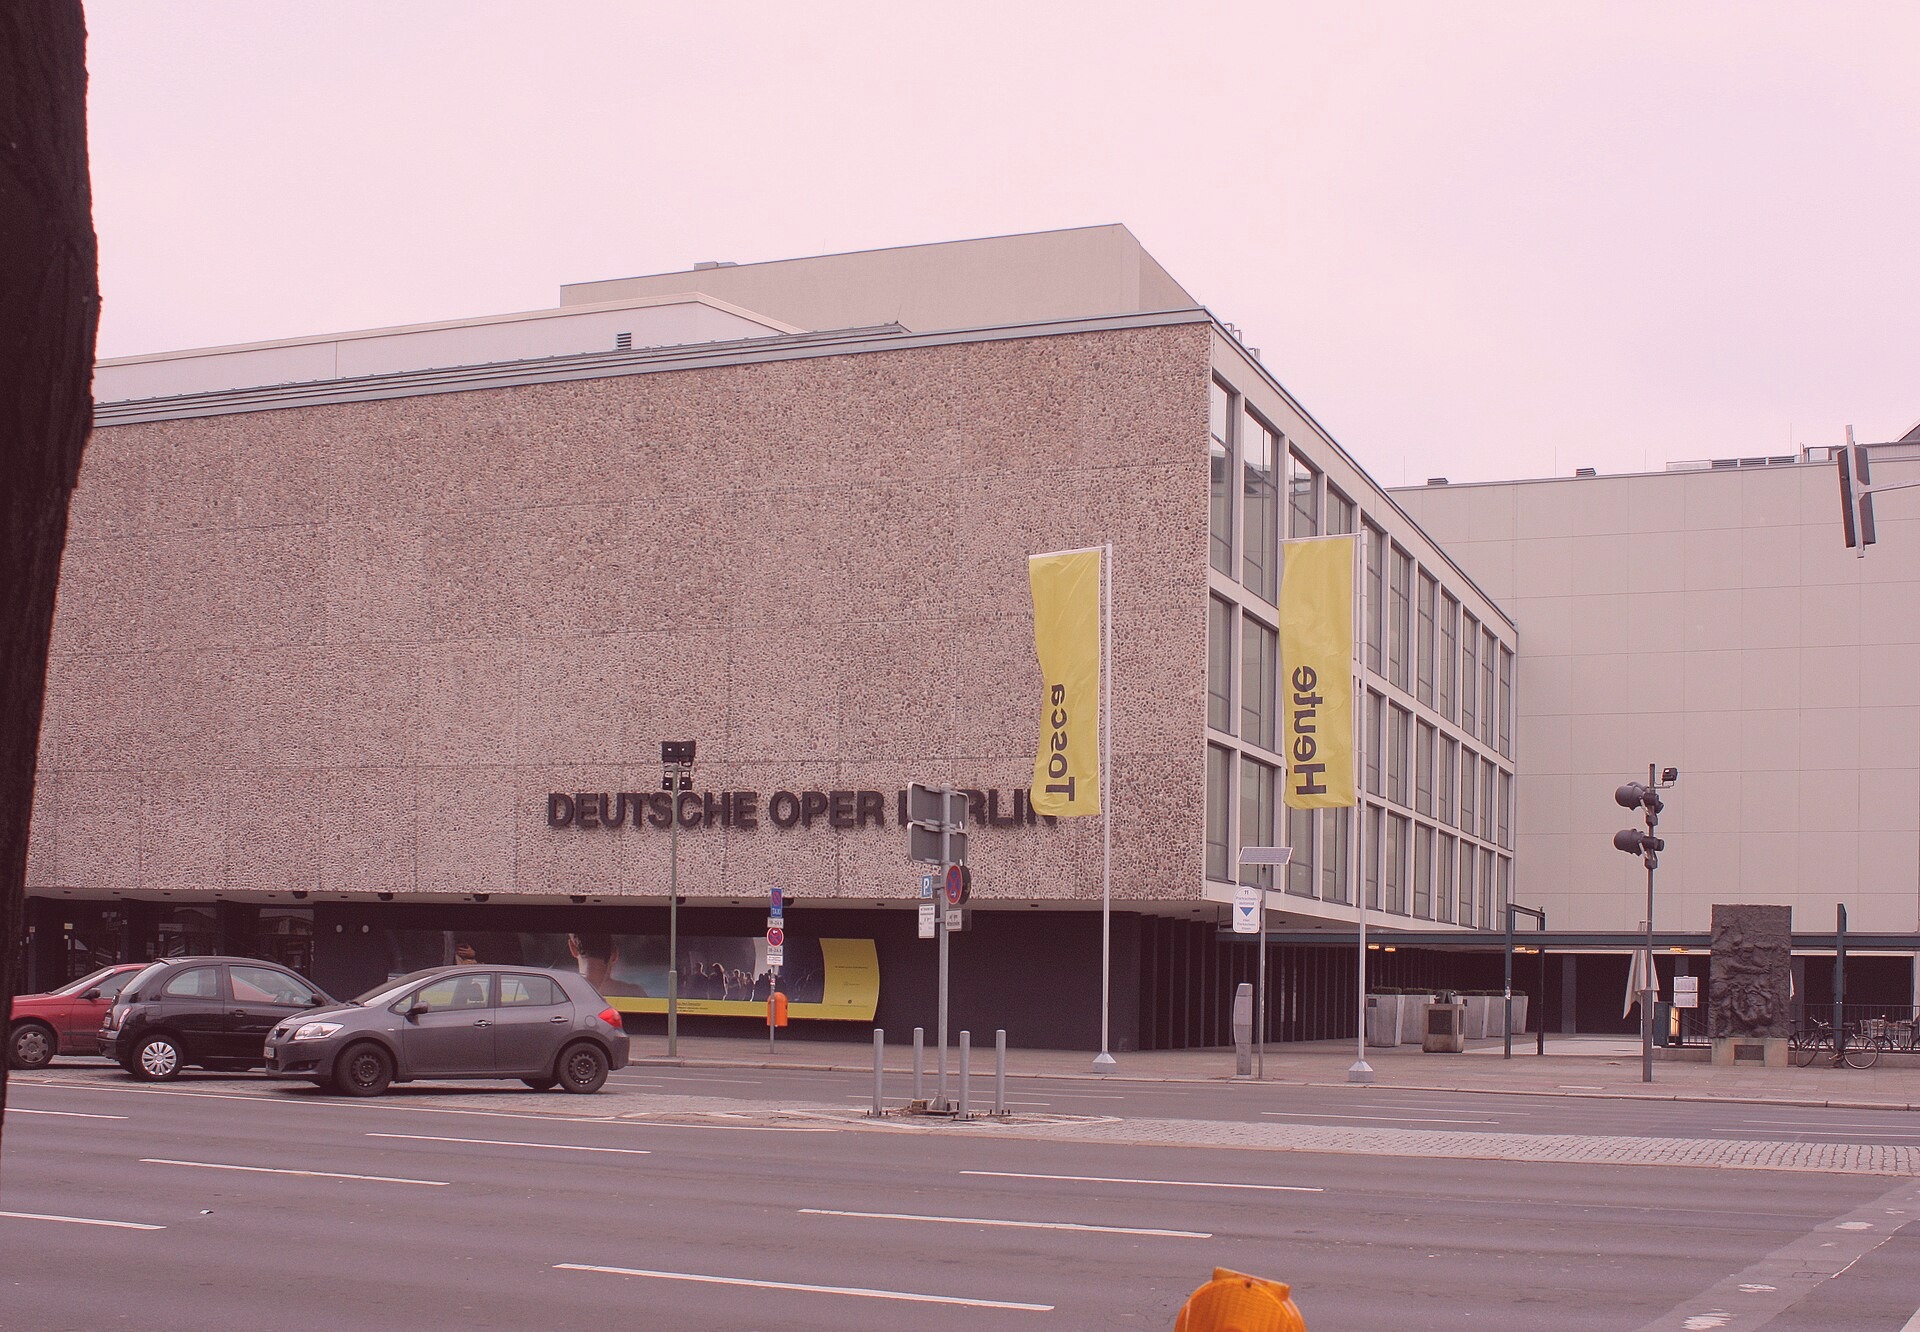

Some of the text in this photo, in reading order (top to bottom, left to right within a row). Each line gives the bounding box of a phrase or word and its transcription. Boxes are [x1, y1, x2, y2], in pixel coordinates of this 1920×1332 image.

[547, 788, 1058, 829] DEUTSCHE OPER RLI
[923, 878, 930, 896] P
